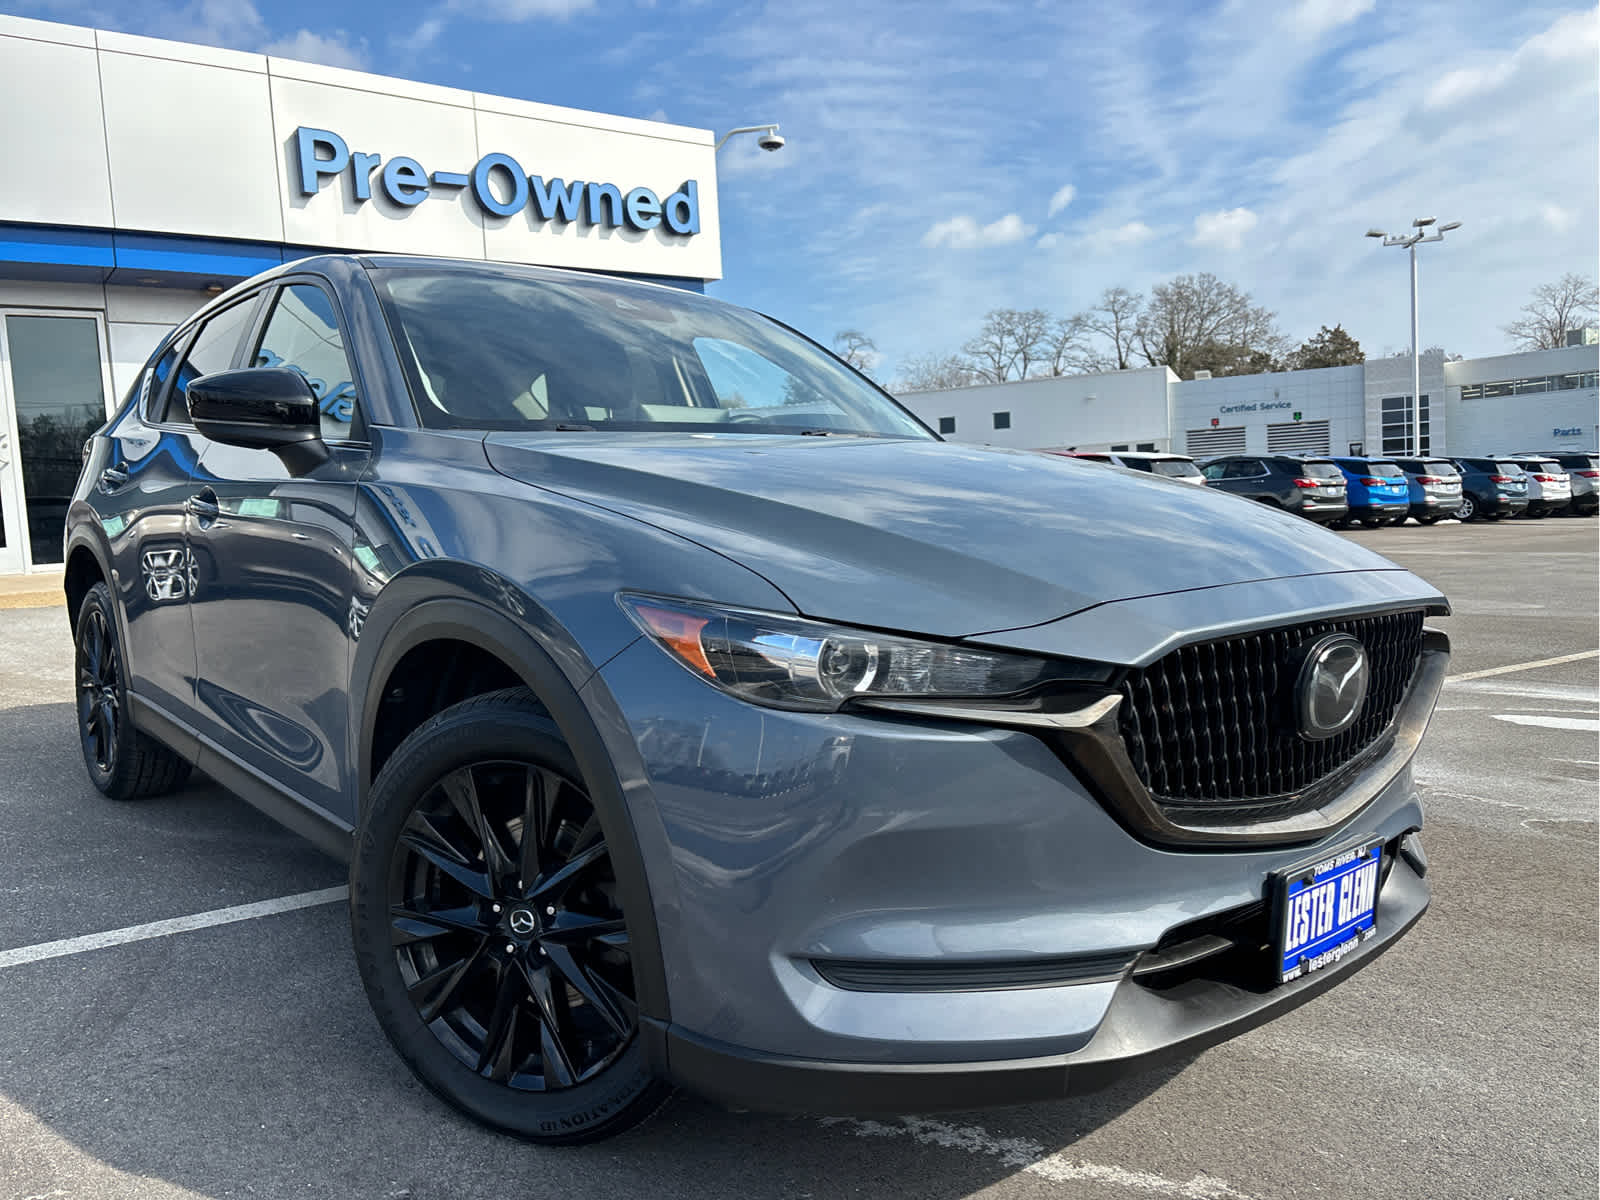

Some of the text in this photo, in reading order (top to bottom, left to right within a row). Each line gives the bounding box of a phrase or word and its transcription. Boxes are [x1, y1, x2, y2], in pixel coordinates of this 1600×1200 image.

[293, 126, 701, 236] Pre-Owned
[1220, 401, 1292, 414] Certified Service
[1553, 427, 1583, 437] Parts
[1314, 860, 1336, 876] TOMS
[1284, 862, 1378, 953] LESTER GLENN
